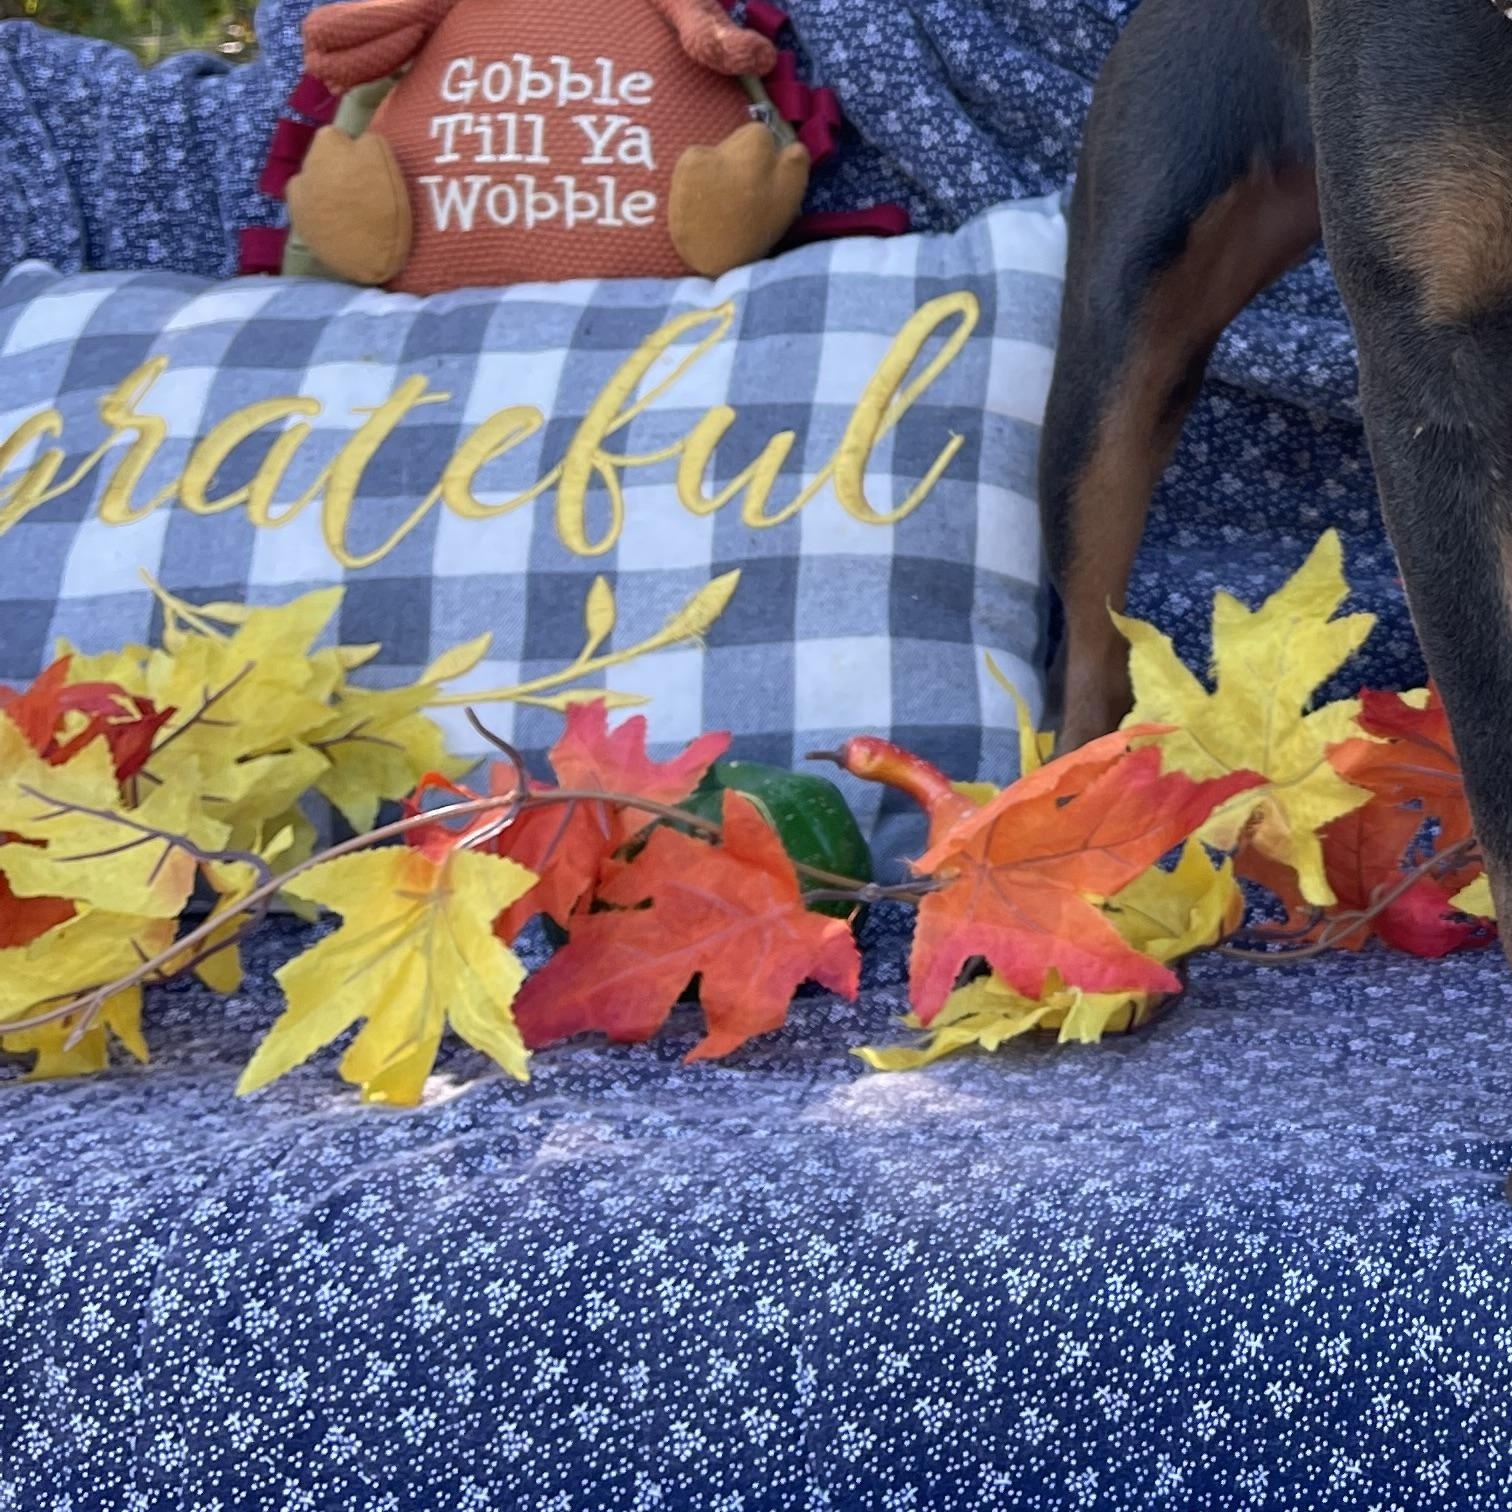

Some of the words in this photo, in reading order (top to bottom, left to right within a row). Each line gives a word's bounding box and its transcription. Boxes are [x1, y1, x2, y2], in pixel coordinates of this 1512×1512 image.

[441, 52, 654, 107] Gobble
[430, 112, 550, 164] Till
[571, 114, 657, 170] Ya
[416, 174, 657, 232] Wobble
